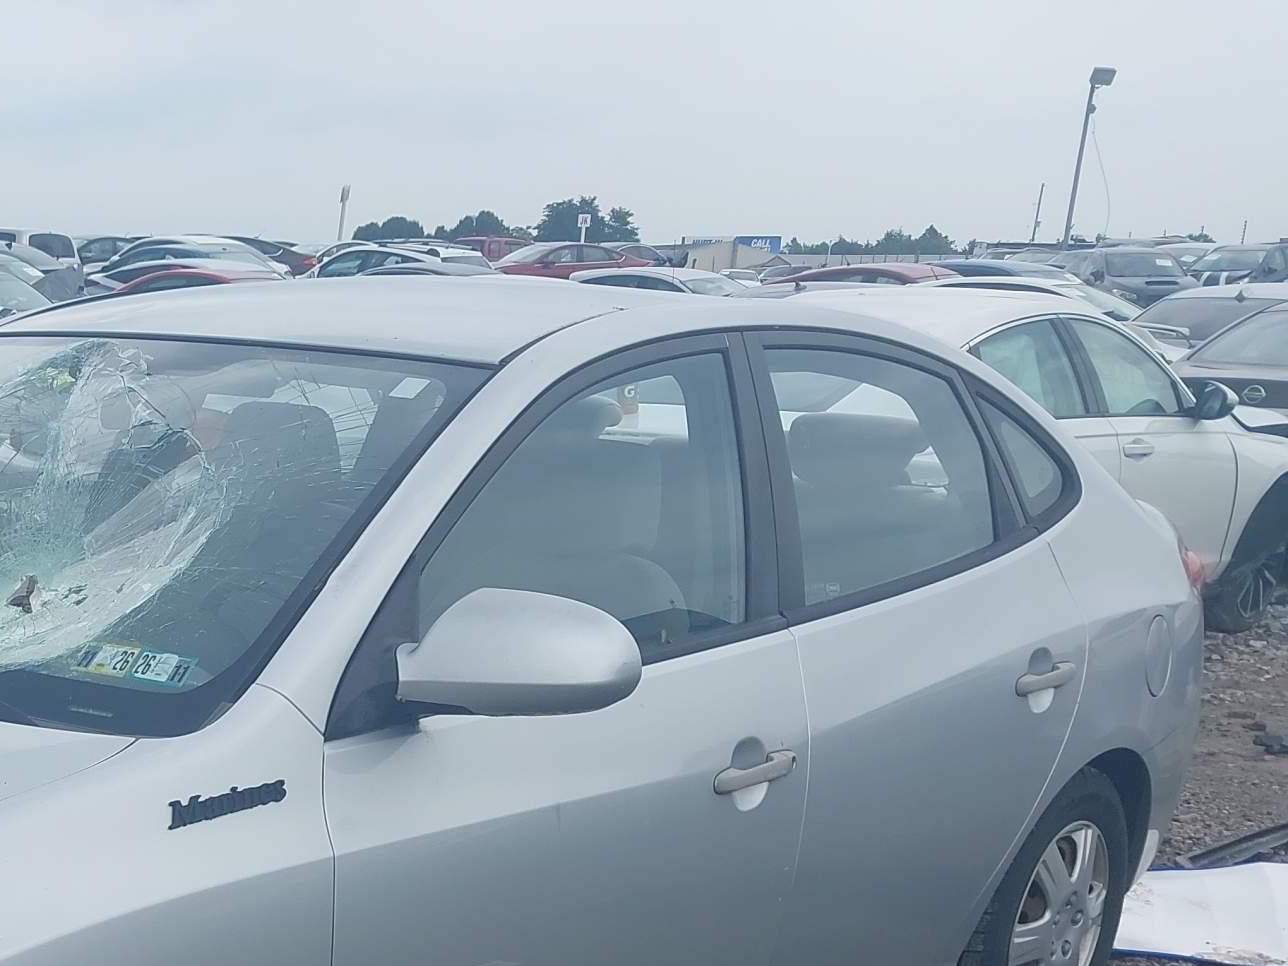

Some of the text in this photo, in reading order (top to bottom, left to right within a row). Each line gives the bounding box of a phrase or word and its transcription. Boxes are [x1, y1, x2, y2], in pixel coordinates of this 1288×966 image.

[751, 239, 771, 248] CALL
[623, 385, 635, 398] G
[112, 650, 136, 672] 26
[133, 654, 156, 676] 26
